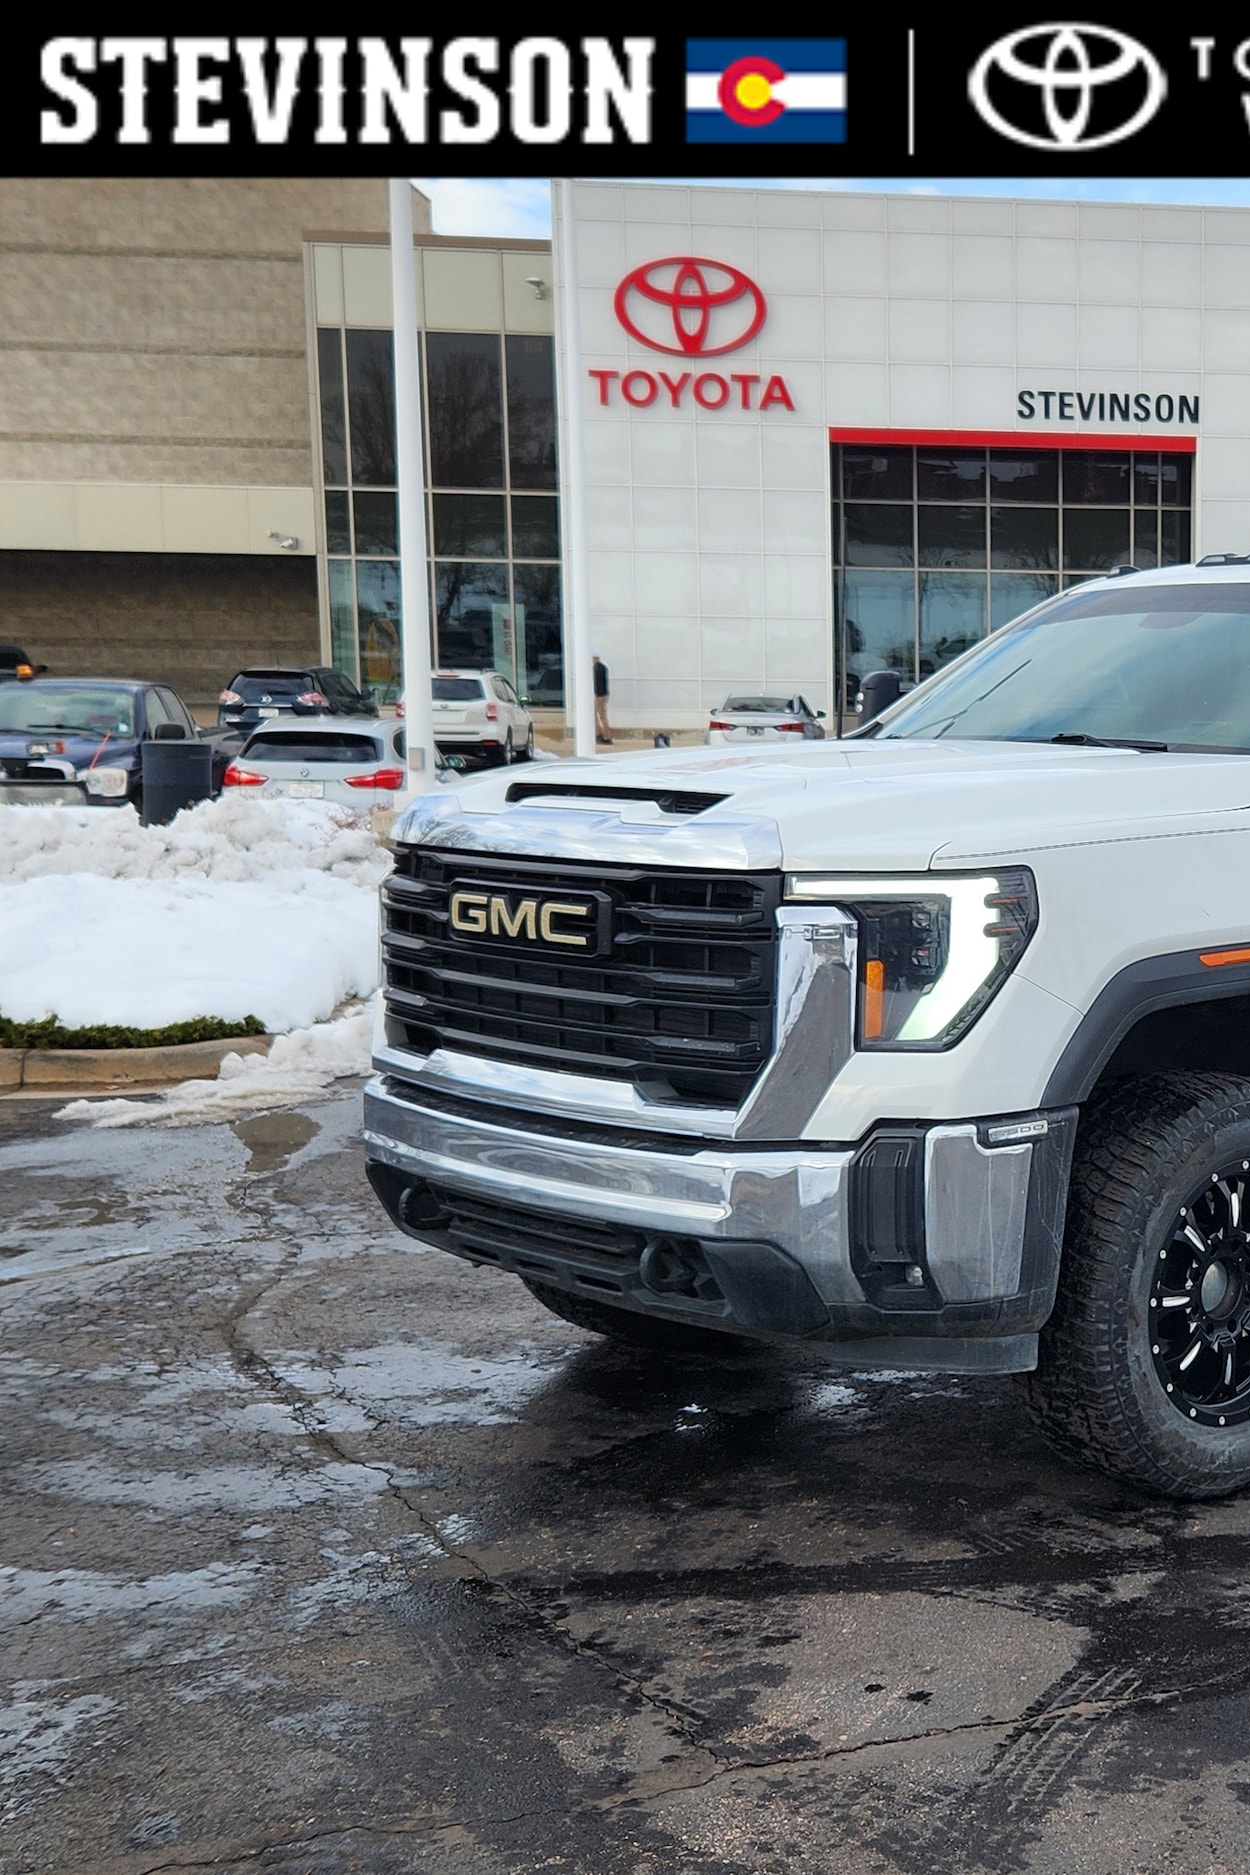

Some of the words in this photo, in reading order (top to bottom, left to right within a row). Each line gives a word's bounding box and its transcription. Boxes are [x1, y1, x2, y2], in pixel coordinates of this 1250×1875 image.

[588, 369, 796, 411] TOYOTA
[1017, 390, 1200, 424] STEVINSON
[451, 892, 588, 946] GMC
